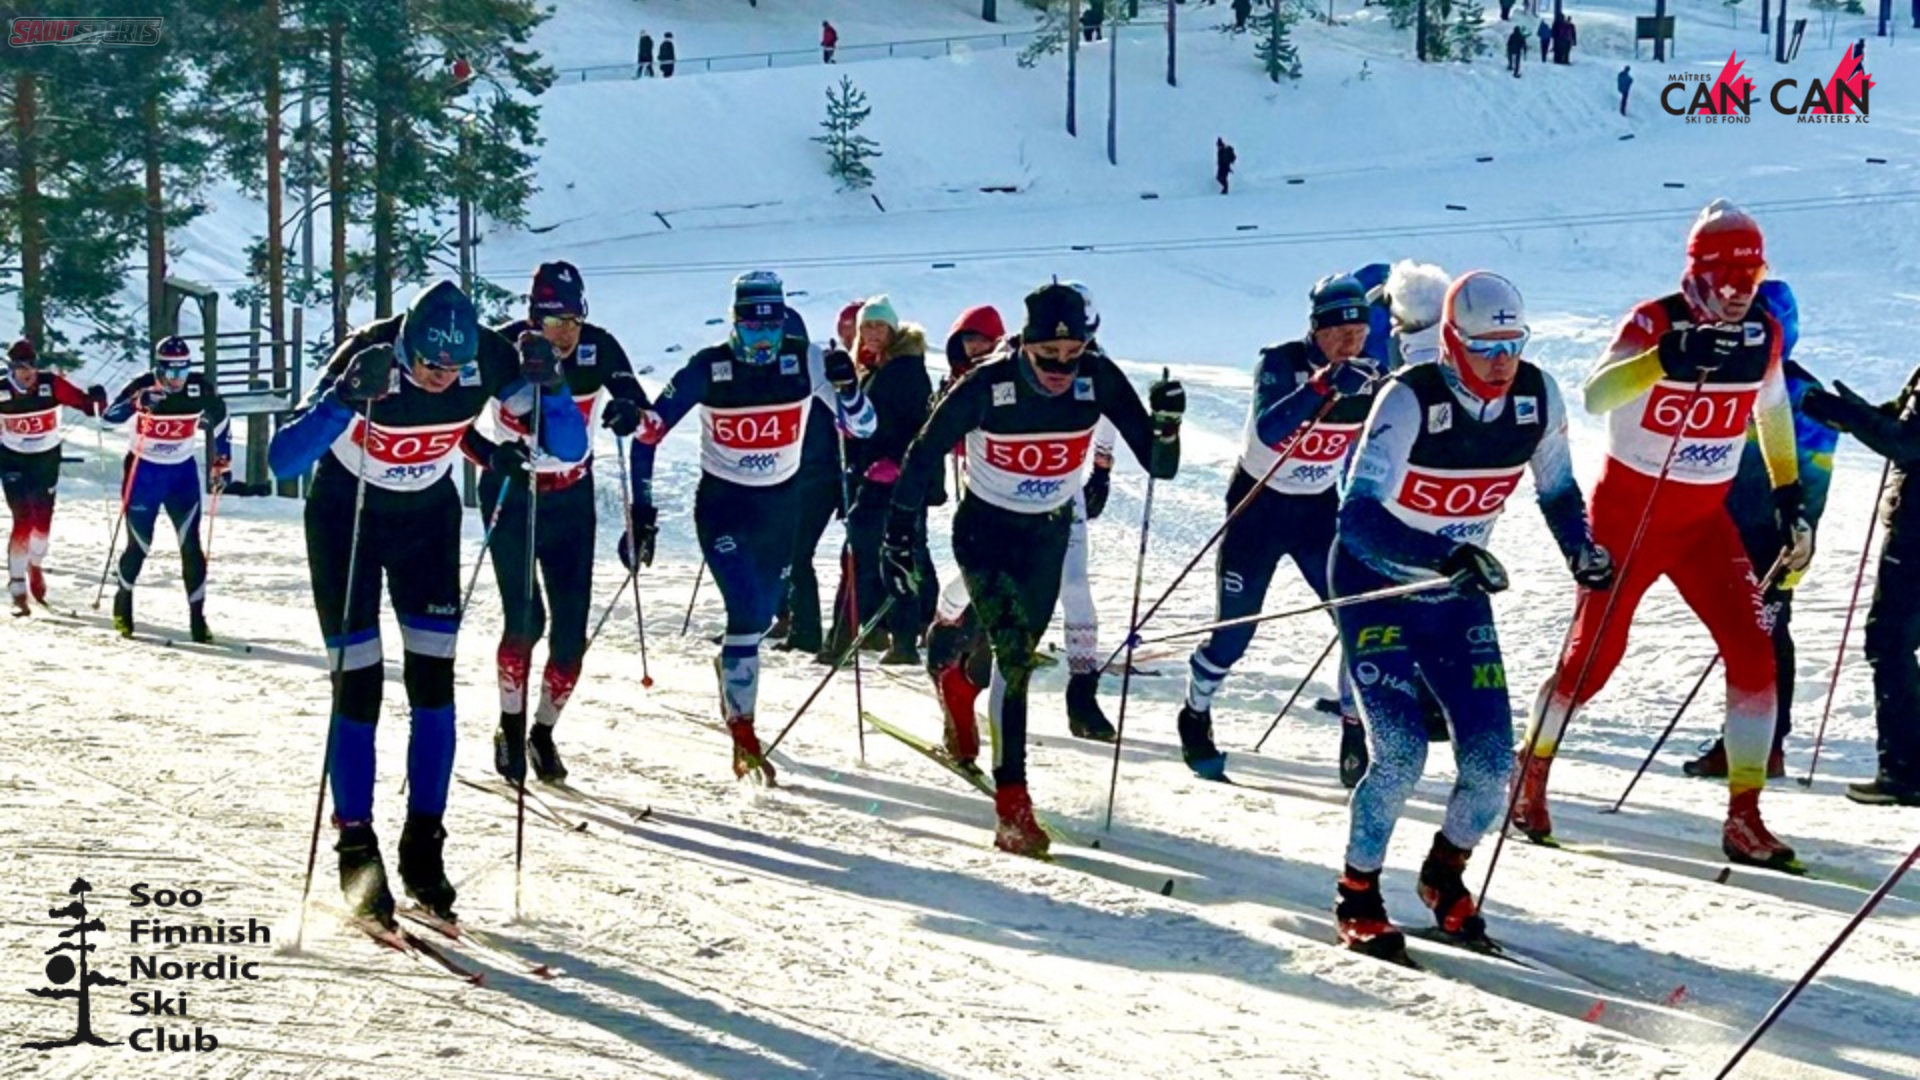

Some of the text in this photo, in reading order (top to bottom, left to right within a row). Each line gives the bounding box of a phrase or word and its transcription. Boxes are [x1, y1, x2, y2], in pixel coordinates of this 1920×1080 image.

[1653, 394, 1739, 430] 601
[715, 415, 782, 443] 604
[992, 443, 1069, 472] 503
[1409, 479, 1511, 514] 506
